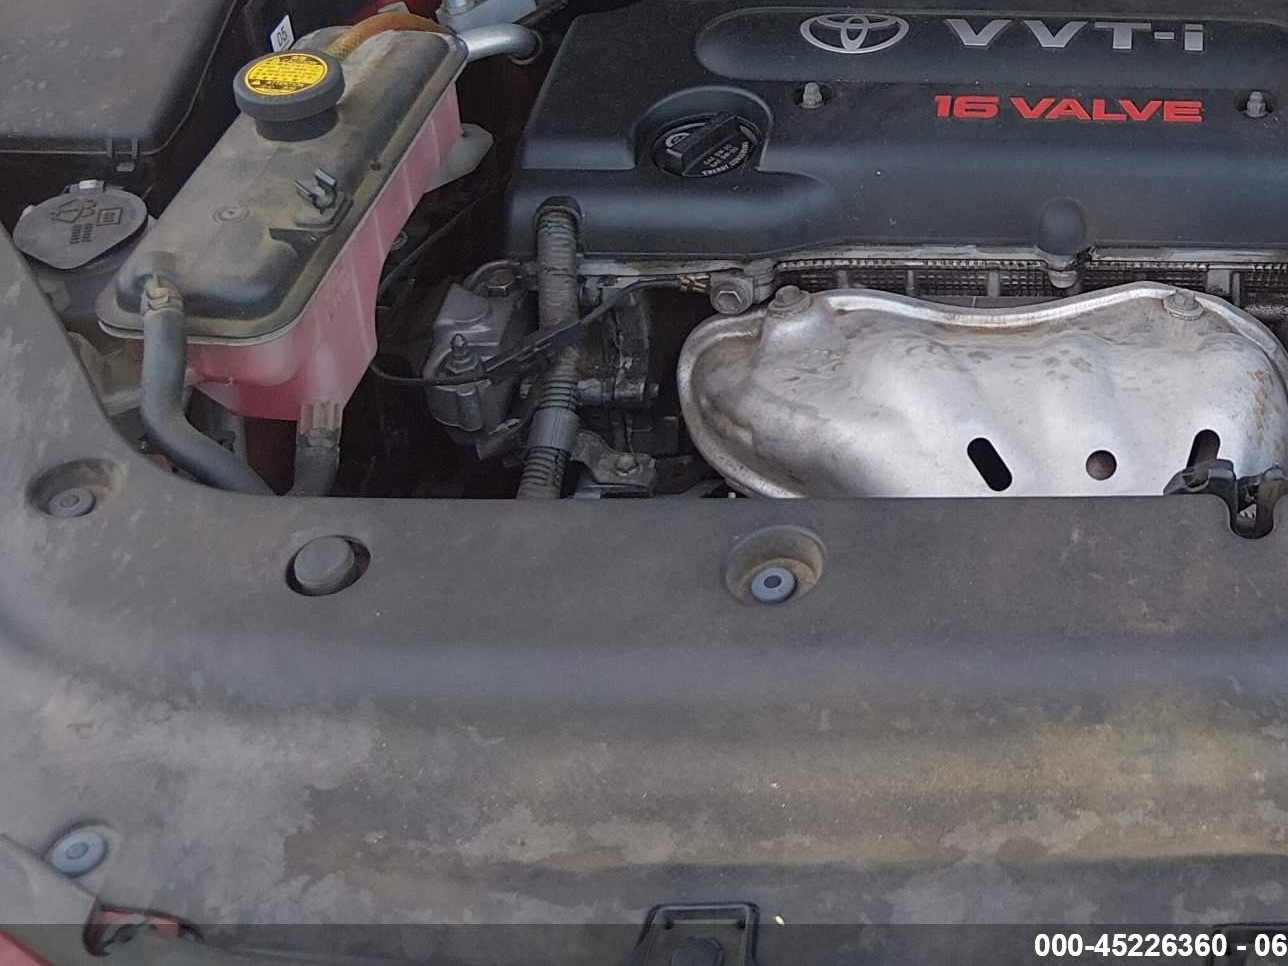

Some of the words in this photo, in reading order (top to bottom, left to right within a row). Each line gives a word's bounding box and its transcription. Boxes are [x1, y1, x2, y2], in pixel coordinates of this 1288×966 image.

[946, 17, 1204, 51] VVT-i
[933, 94, 1001, 119] 16
[1009, 97, 1204, 123] VALVE
